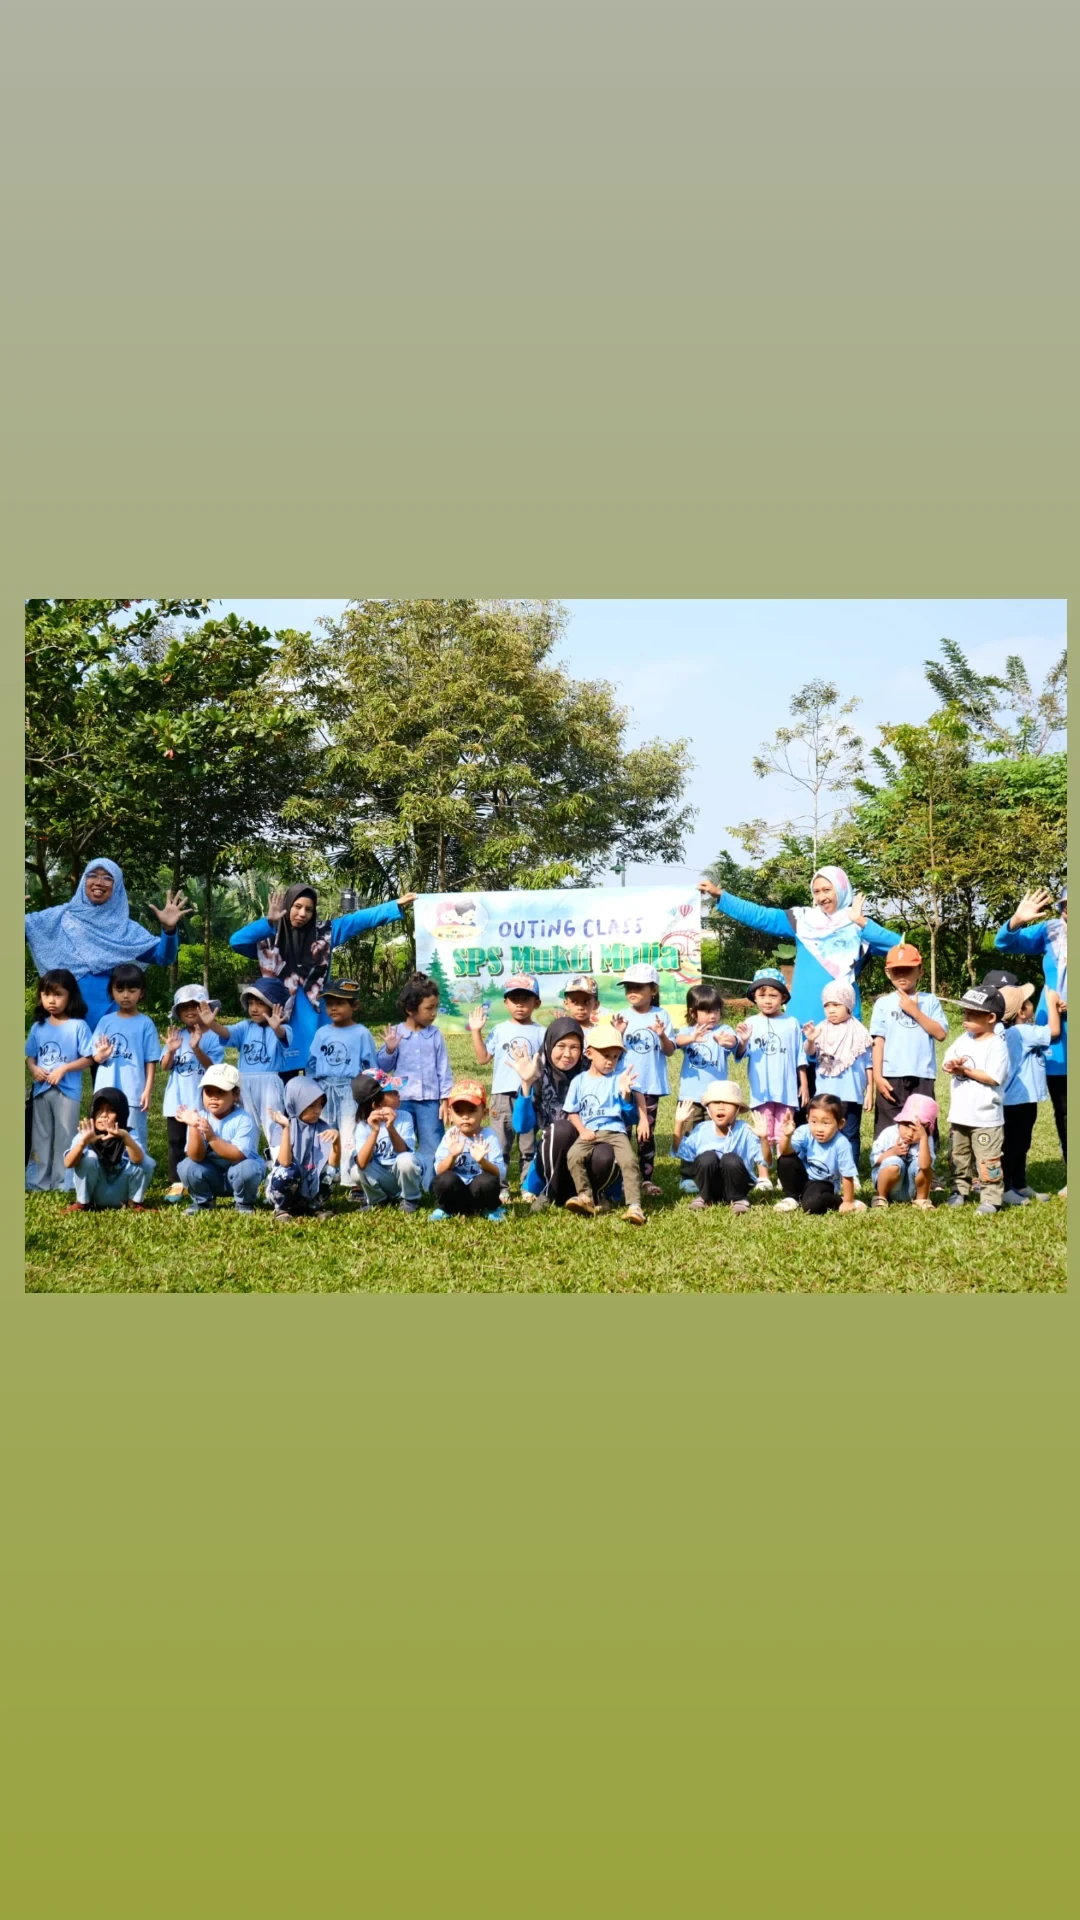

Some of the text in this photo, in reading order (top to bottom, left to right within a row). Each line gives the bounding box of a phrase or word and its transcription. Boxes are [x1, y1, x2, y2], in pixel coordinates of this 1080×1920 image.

[583, 917, 643, 938] CLASS
[452, 941, 681, 978] SPS Mukti Mulia
